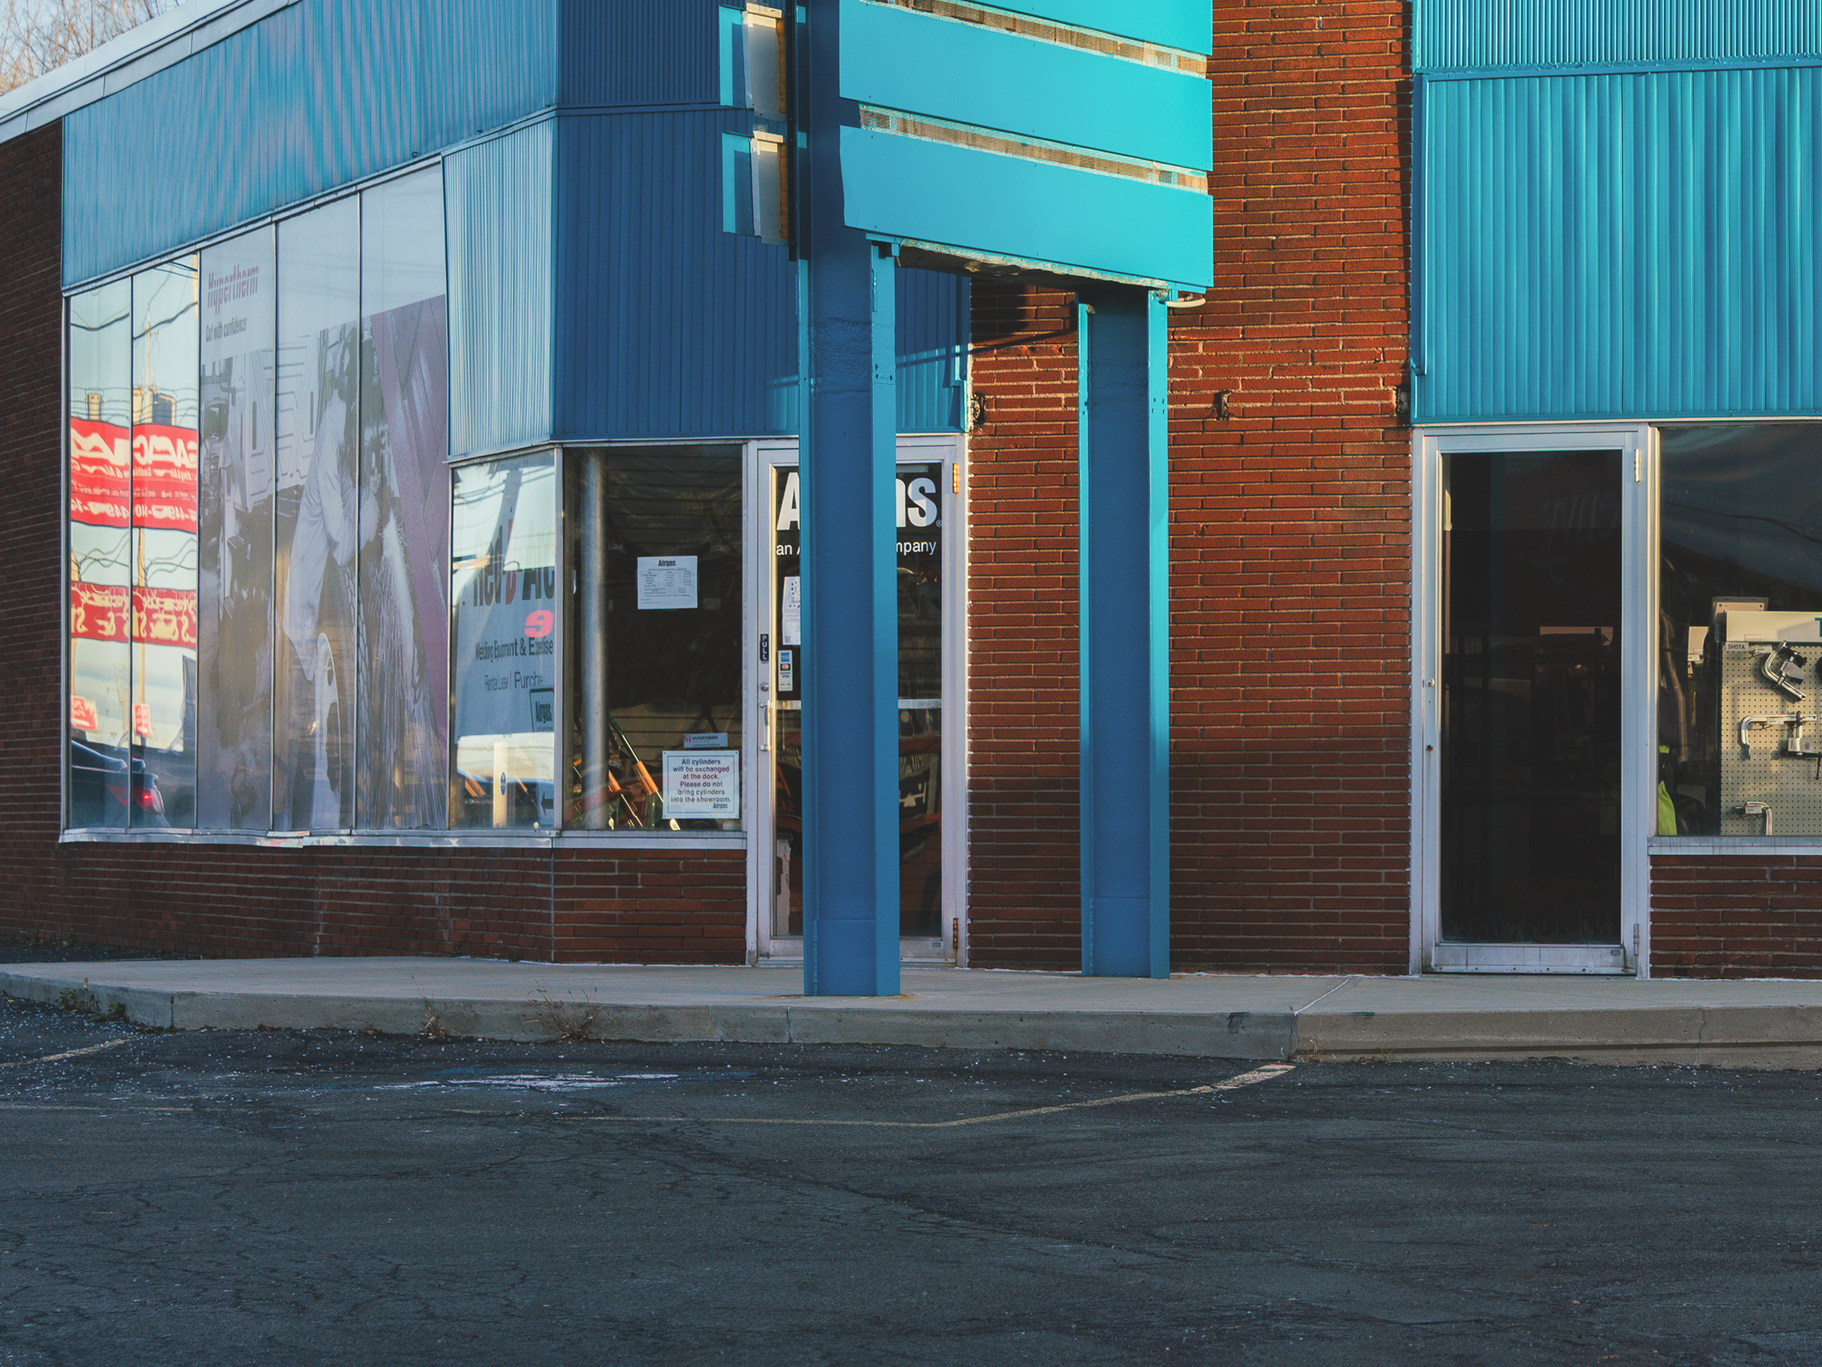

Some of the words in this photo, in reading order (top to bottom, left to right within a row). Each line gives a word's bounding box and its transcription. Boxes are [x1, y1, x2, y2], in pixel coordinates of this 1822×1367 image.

[207, 264, 259, 315] Hypertherm
[776, 544, 793, 556] an
[657, 559, 677, 567] Airgas
[520, 637, 527, 656] &
[691, 758, 721, 766] cylinders
